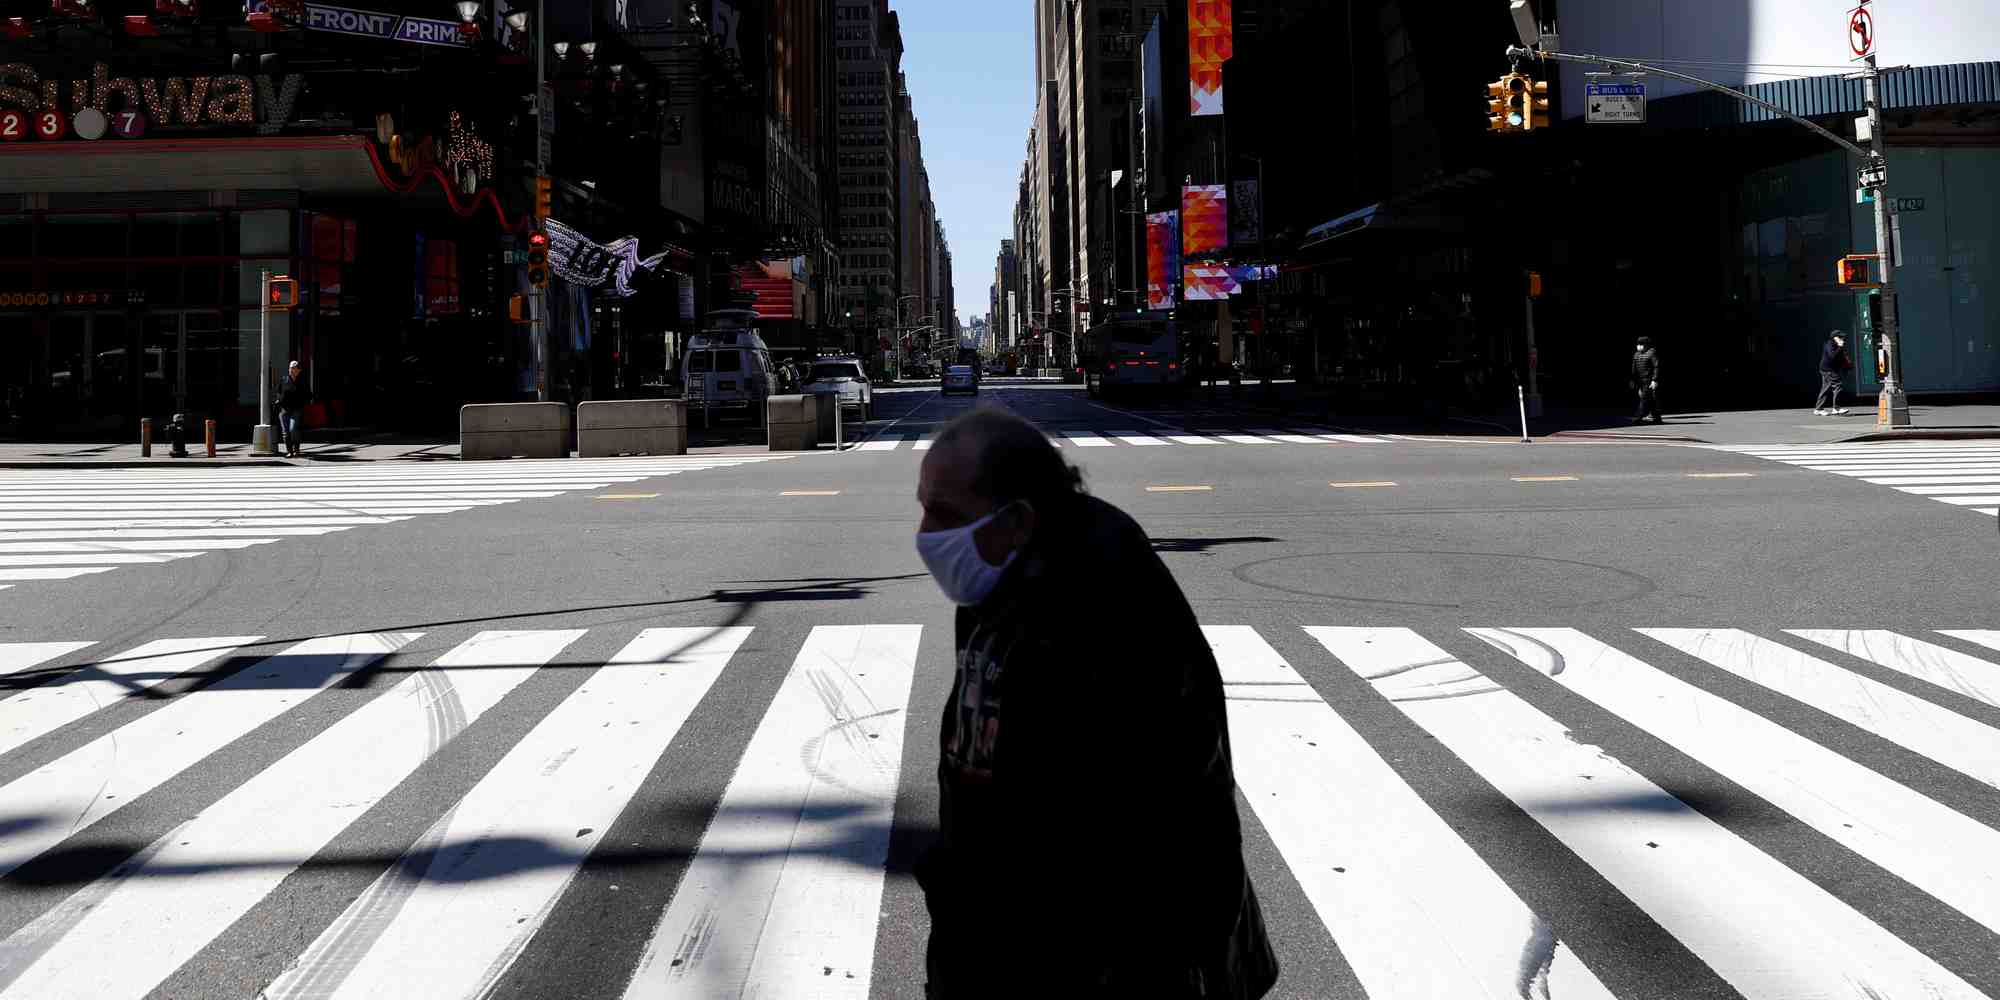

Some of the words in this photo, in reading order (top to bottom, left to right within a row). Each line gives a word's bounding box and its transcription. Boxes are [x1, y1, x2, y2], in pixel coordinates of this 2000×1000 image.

[2, 115, 18, 136] 2
[41, 114, 58, 135] 3
[122, 113, 137, 133] 7
[712, 176, 761, 217] MARCH
